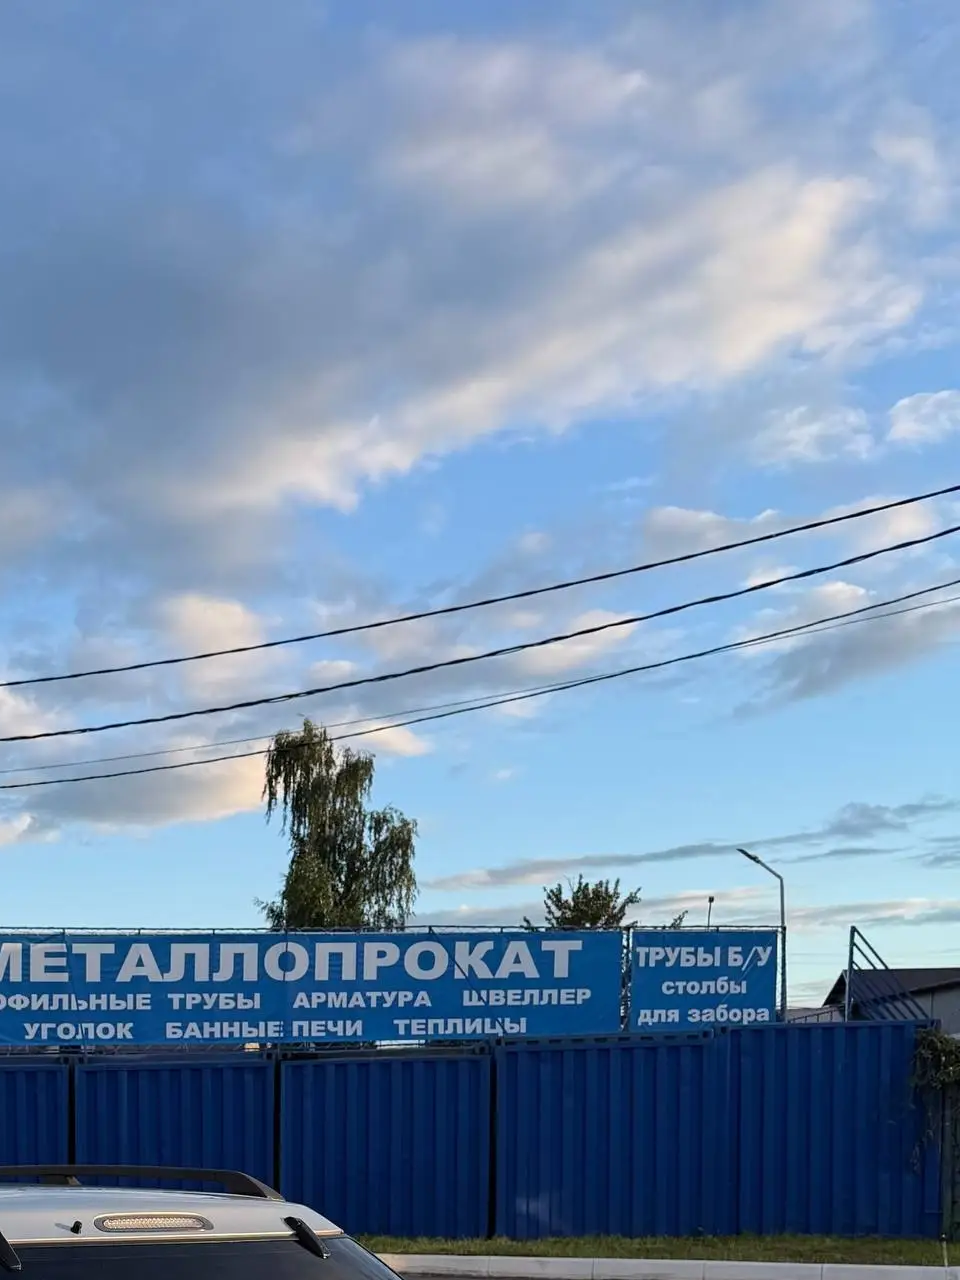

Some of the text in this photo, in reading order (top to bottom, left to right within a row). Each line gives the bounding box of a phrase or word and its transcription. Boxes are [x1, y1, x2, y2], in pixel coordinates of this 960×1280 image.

[636, 945, 773, 972] ТРУБЫ Б/У
[661, 976, 747, 995] столбы
[167, 992, 261, 1010] ТРУБЫ
[293, 990, 432, 1009] АРМАТУРА
[462, 988, 592, 1006] ШВЕЛЛЕР
[637, 1004, 770, 1026] для забора
[24, 1016, 528, 1040] УГОЛОК БАННЫЕ ПЕЧИ ТЕПЛИЦЫ
